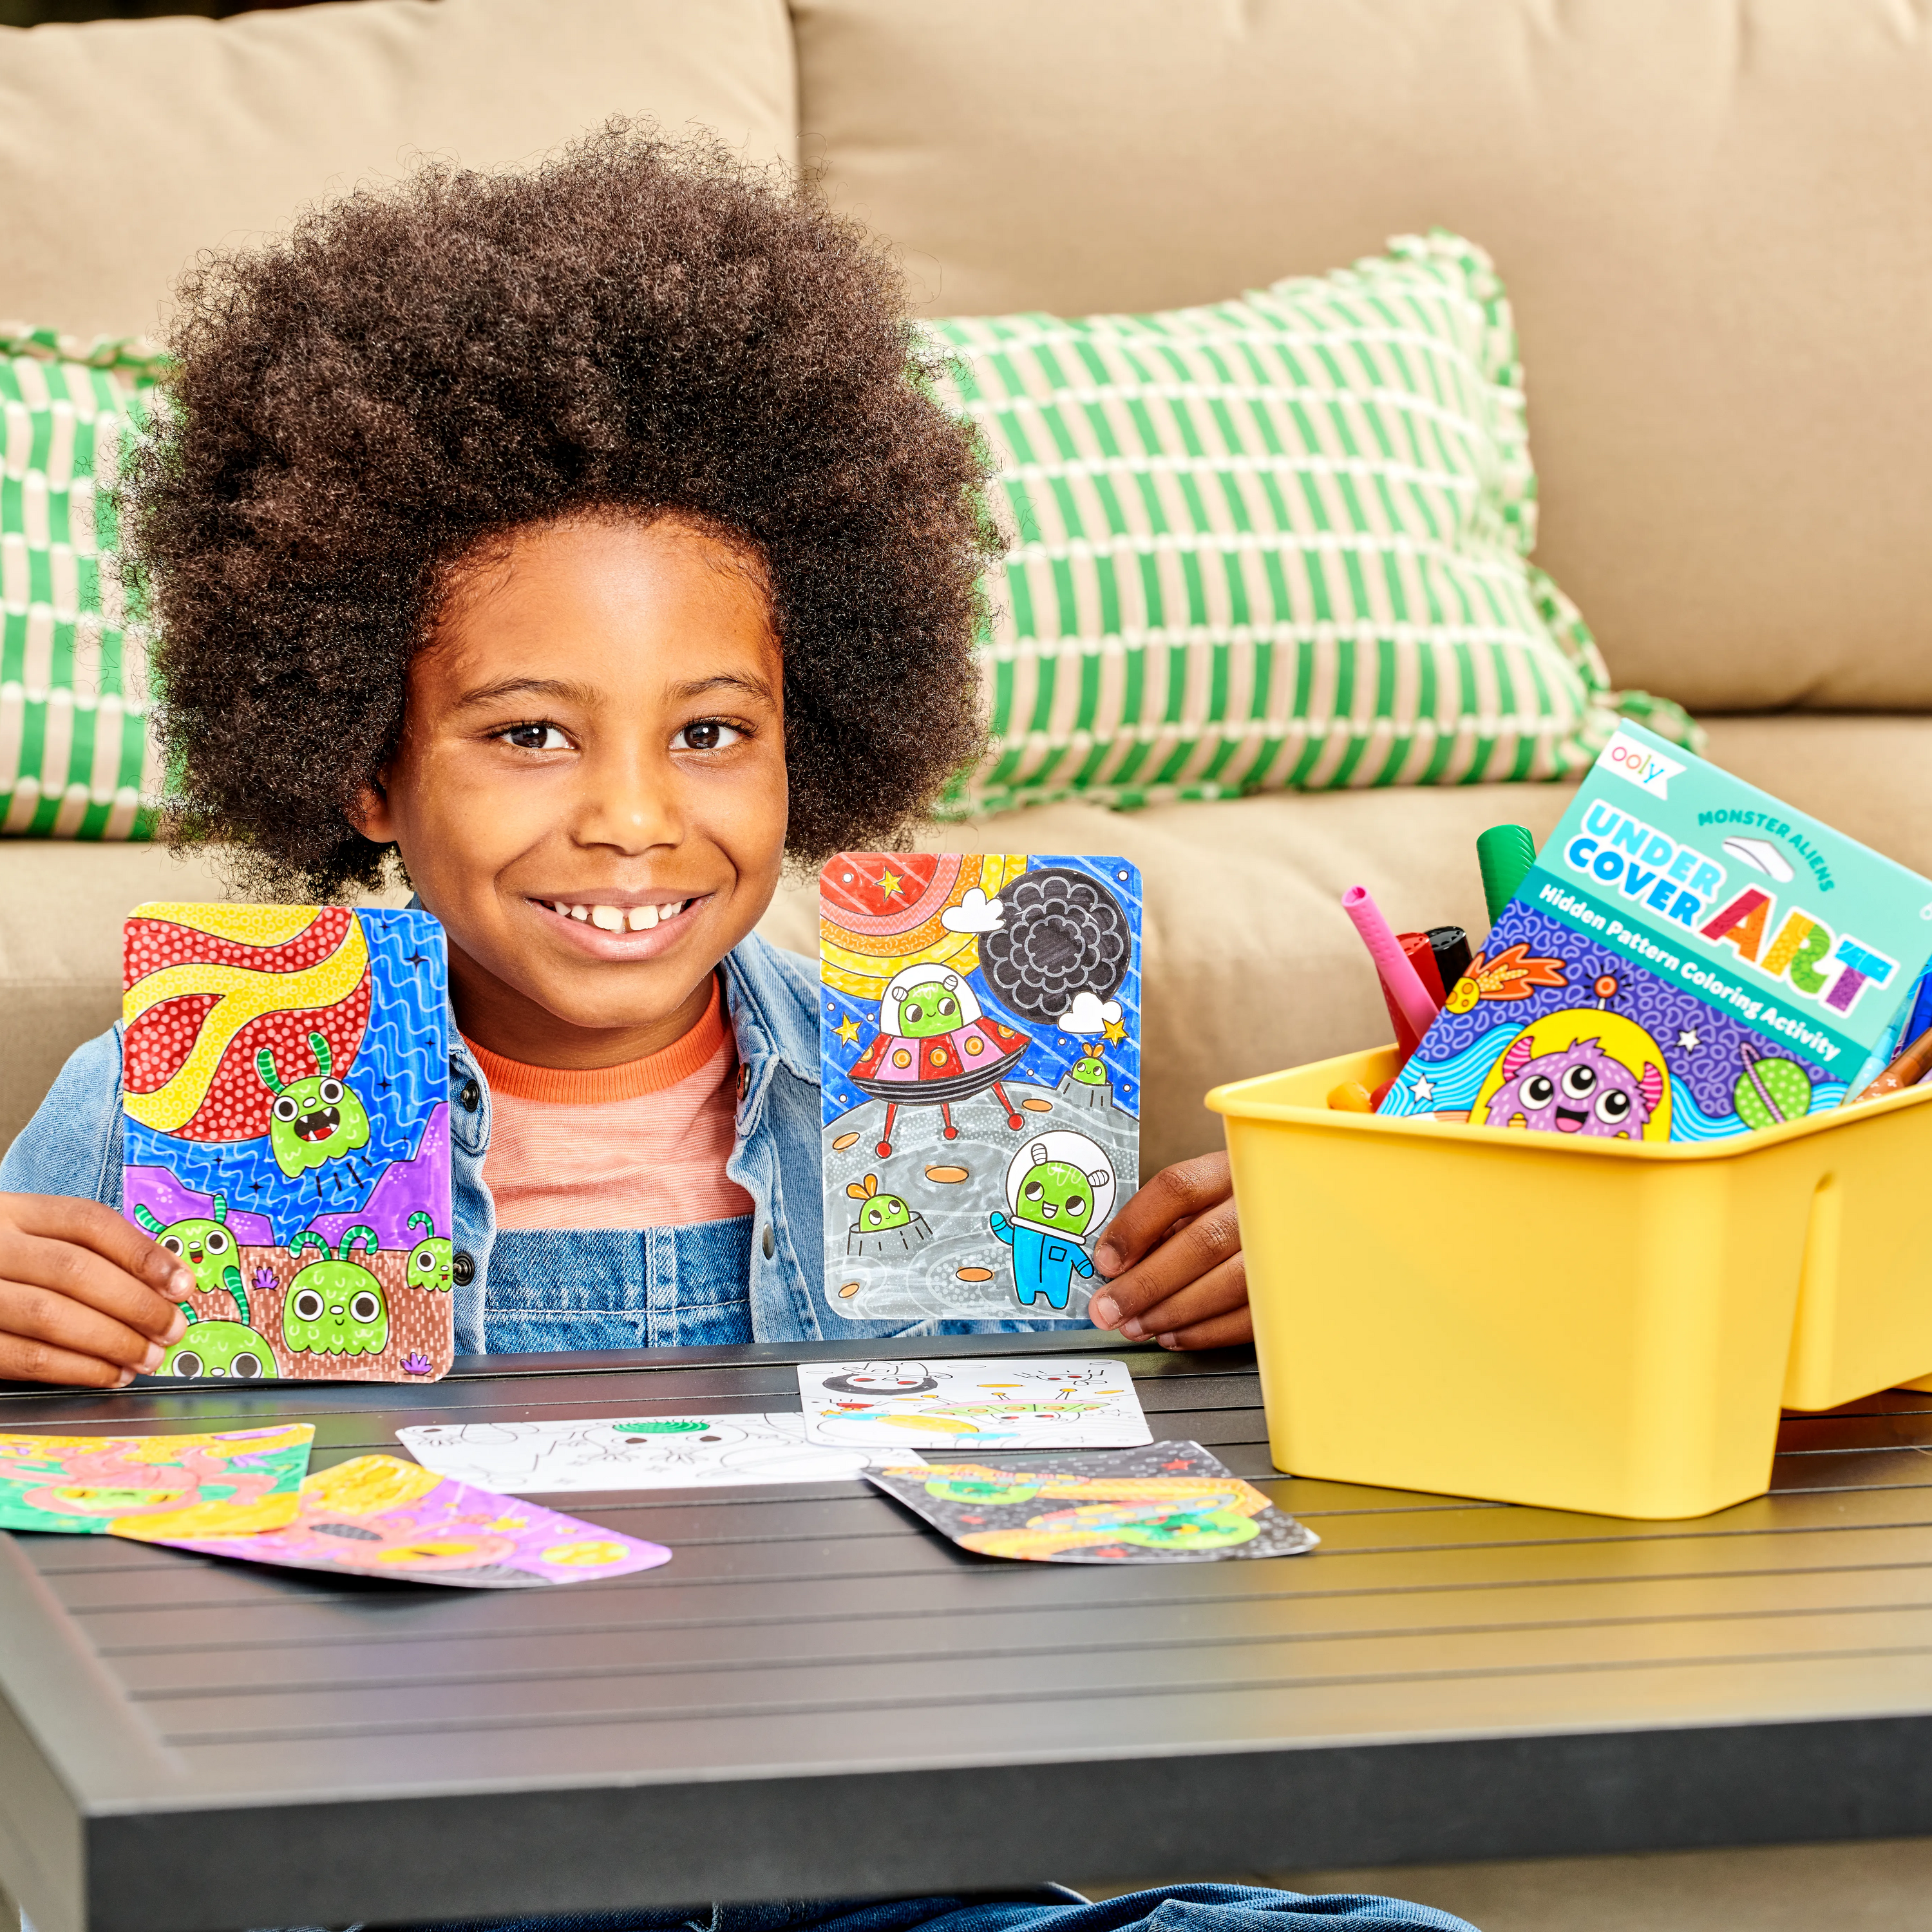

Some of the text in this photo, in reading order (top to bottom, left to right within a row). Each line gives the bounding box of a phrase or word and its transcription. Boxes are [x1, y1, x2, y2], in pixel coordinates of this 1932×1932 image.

[1612, 746, 1664, 783] ooly
[1586, 804, 1721, 898] UNDER
[1698, 809, 1835, 892] MONSTER ALIENS
[1569, 838, 1895, 1012] COVER ART
[1539, 884, 1841, 1062] Hidden Pattern Coloring Activity
